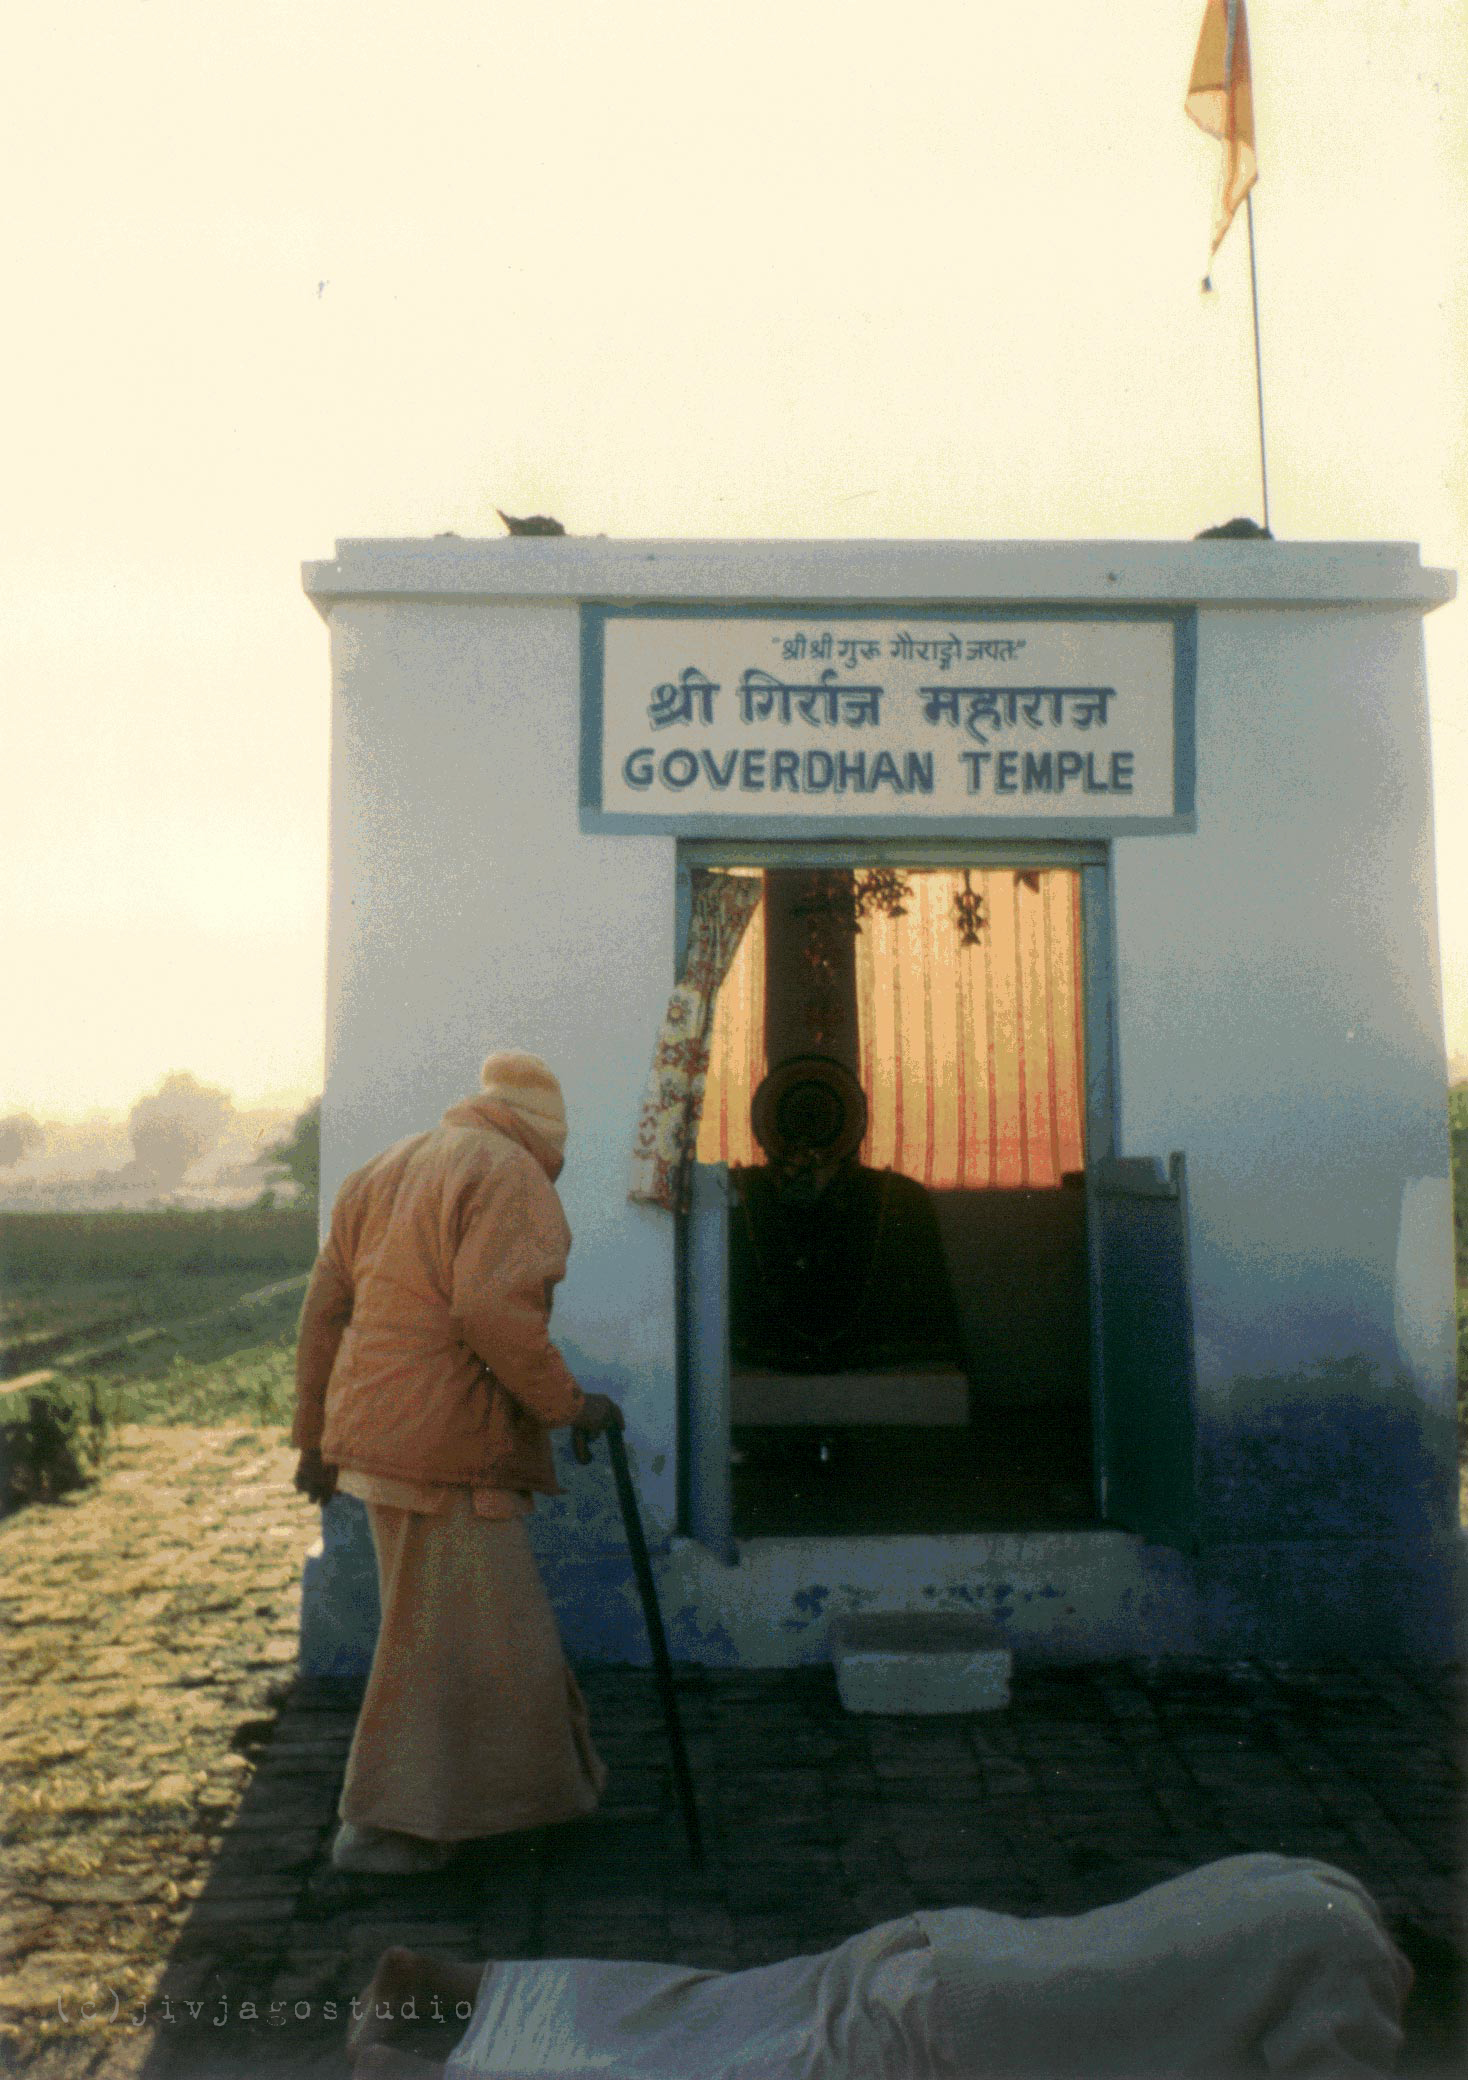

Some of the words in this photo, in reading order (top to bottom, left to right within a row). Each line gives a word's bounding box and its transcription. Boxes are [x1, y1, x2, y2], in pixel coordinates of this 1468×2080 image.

[648, 666, 721, 731] श्री
[917, 685, 1116, 744] महाराज
[621, 746, 935, 796] GOVERDHAN
[960, 749, 1136, 796] TEMPLE
